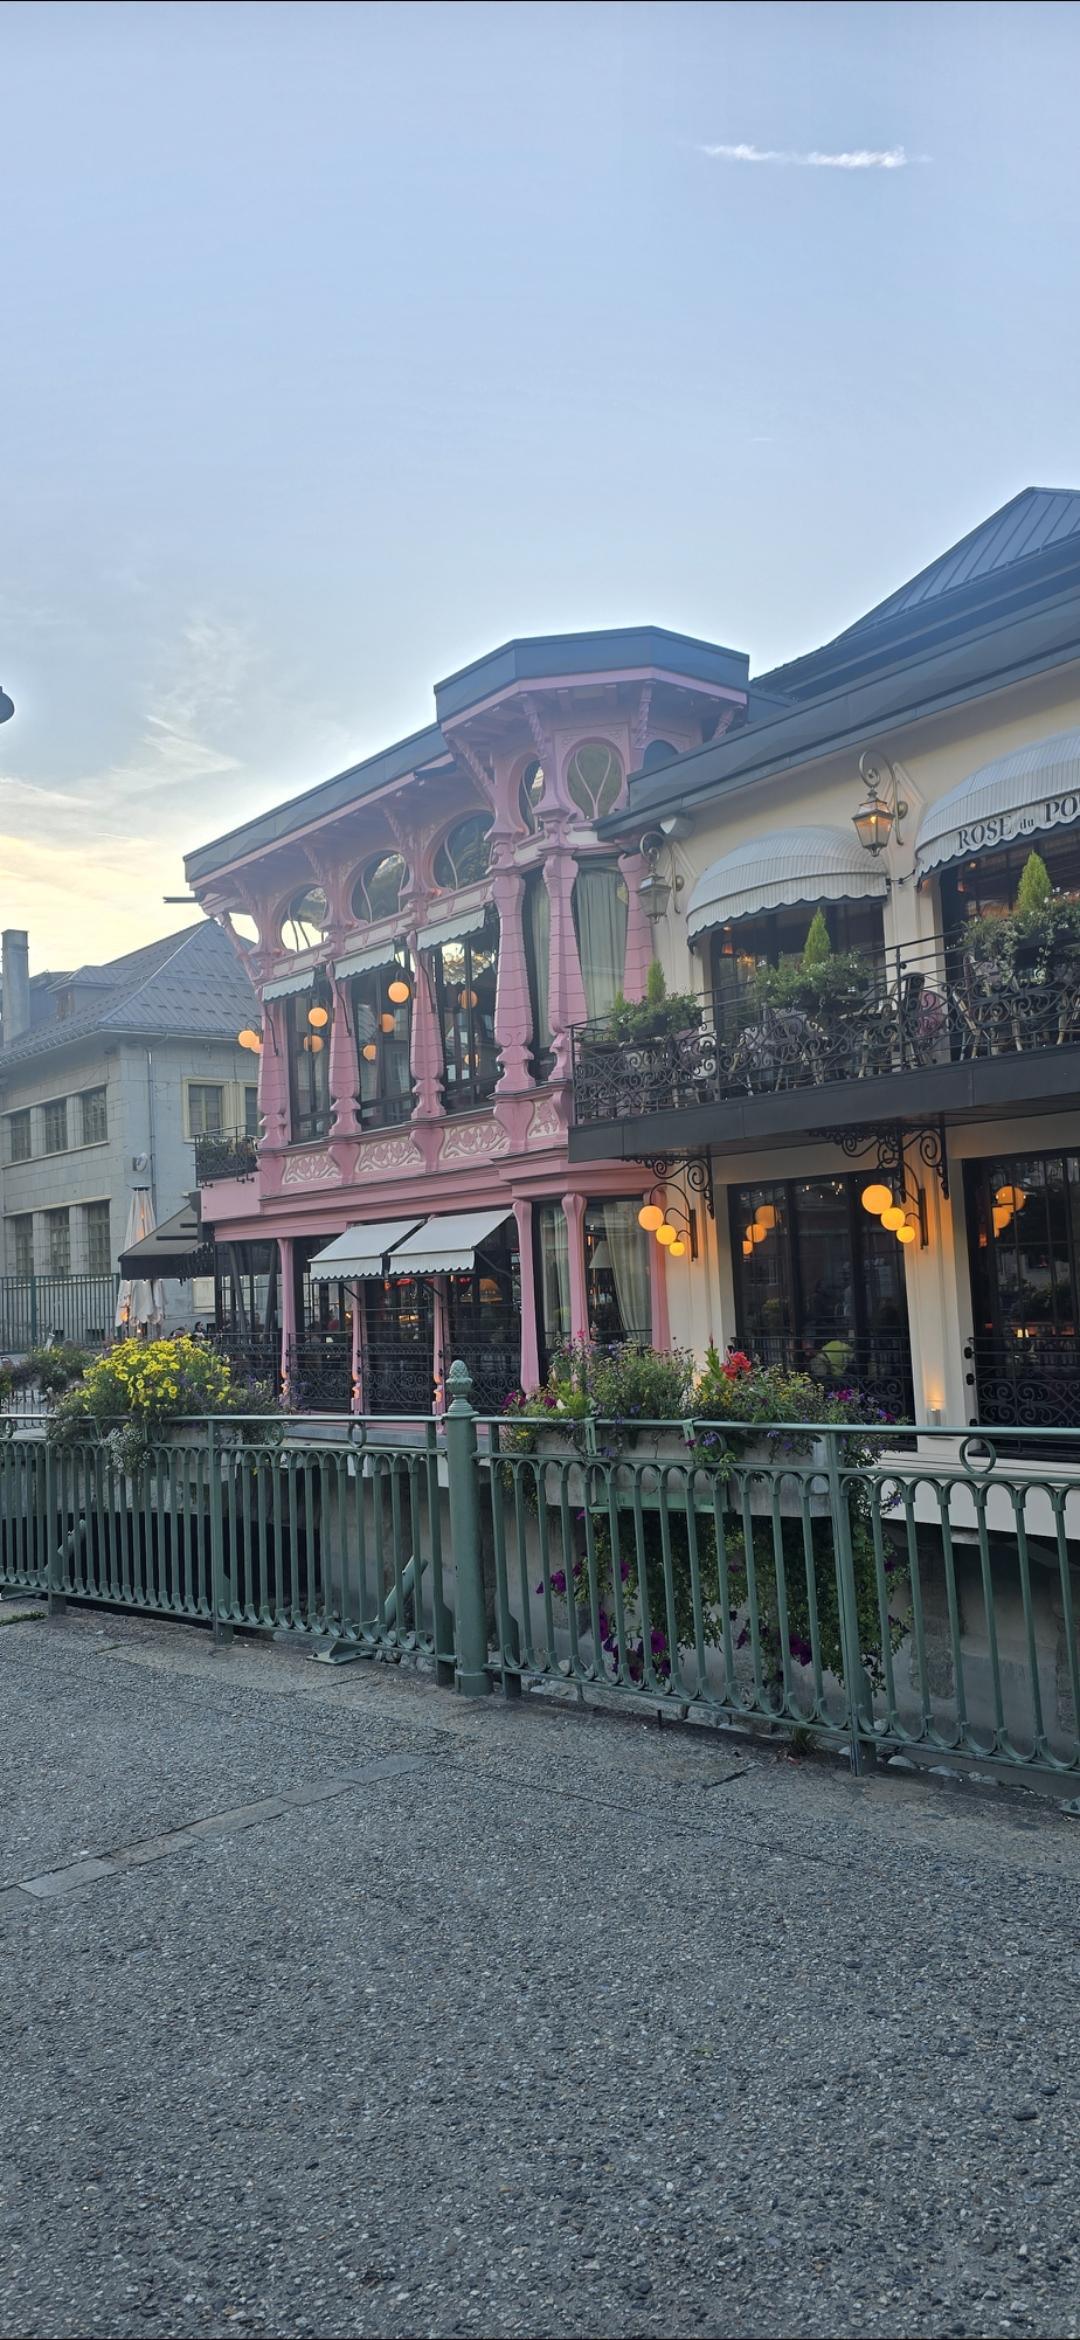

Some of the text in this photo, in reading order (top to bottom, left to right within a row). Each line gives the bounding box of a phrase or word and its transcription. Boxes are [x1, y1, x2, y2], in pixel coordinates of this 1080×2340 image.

[958, 796, 1080, 849] ROSE du PO
